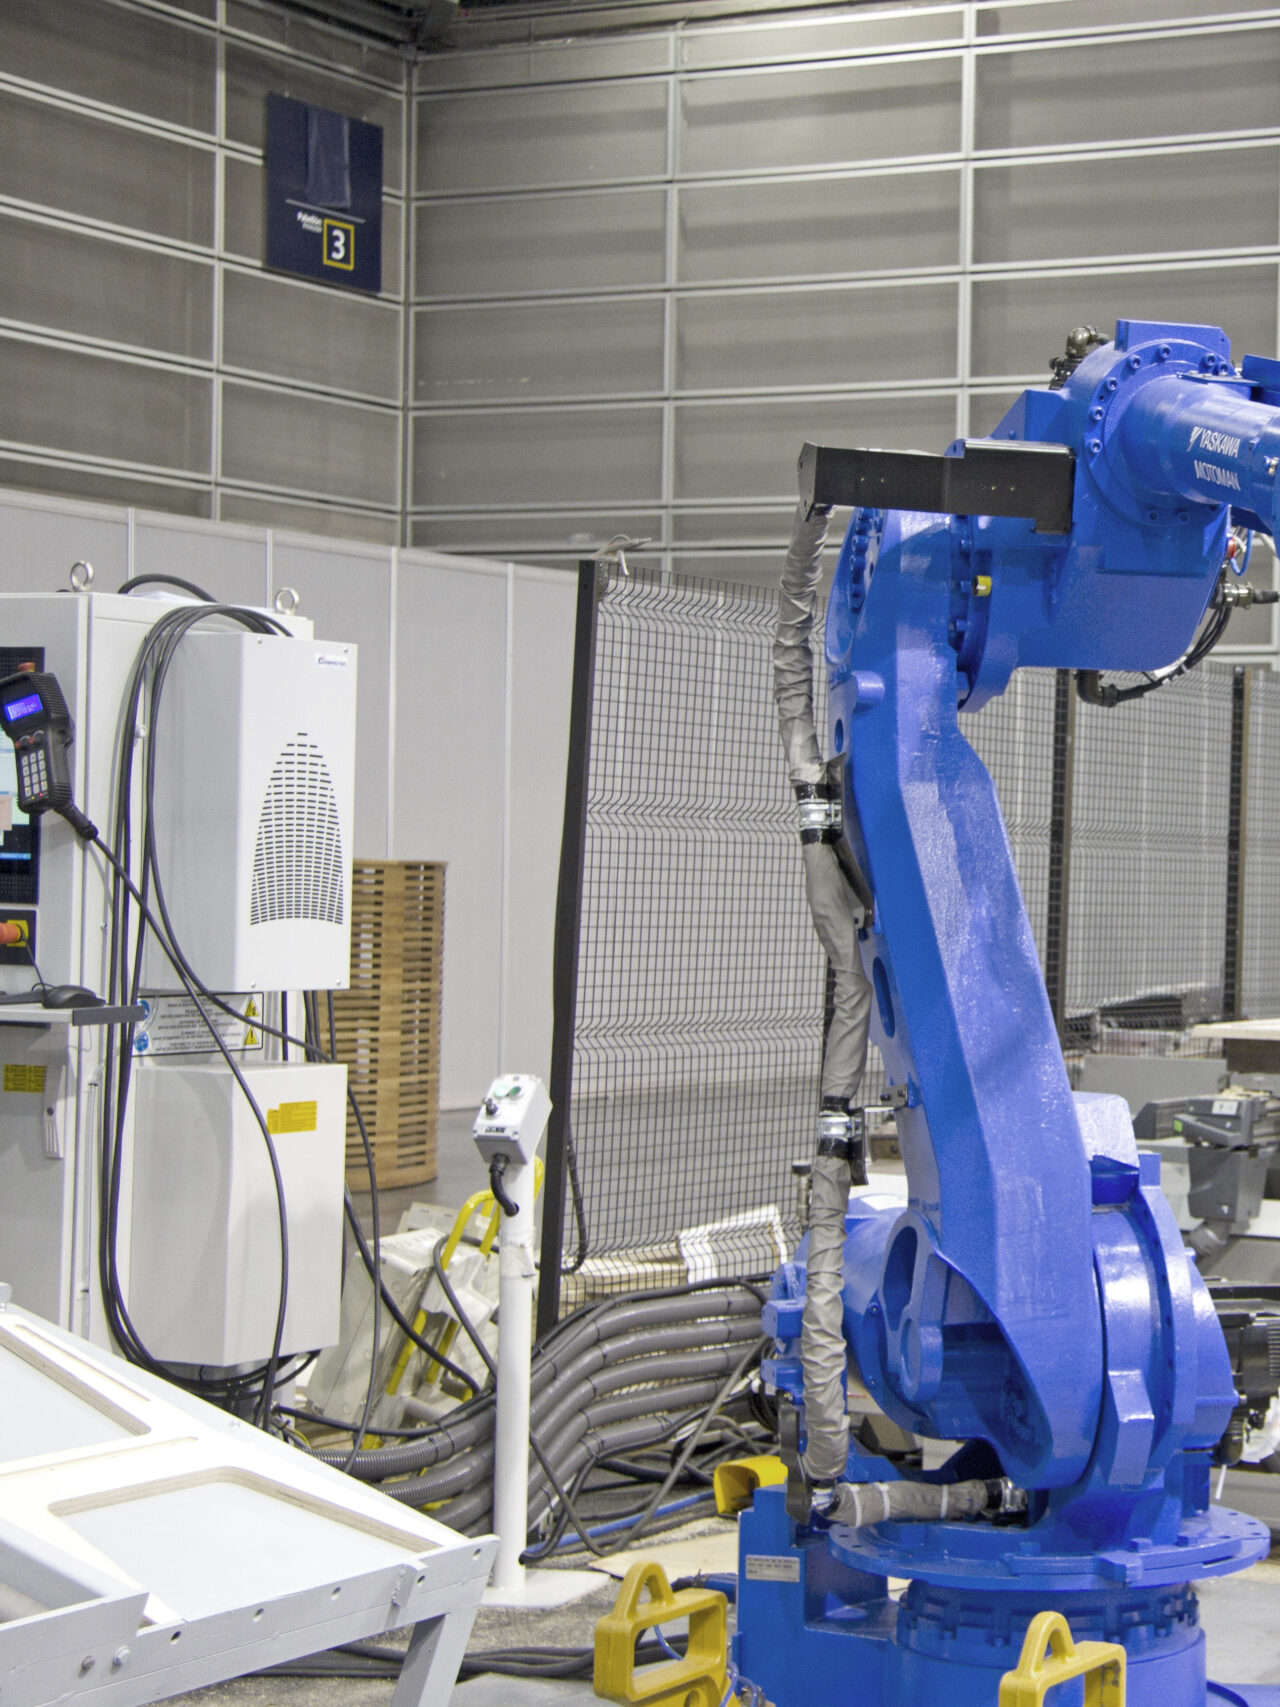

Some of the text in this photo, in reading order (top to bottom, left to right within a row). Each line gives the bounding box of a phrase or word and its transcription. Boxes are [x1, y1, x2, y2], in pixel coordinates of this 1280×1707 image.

[331, 228, 345, 260] 3
[1200, 428, 1241, 458] YASKAWA
[1194, 460, 1241, 491] MOTOMAN
